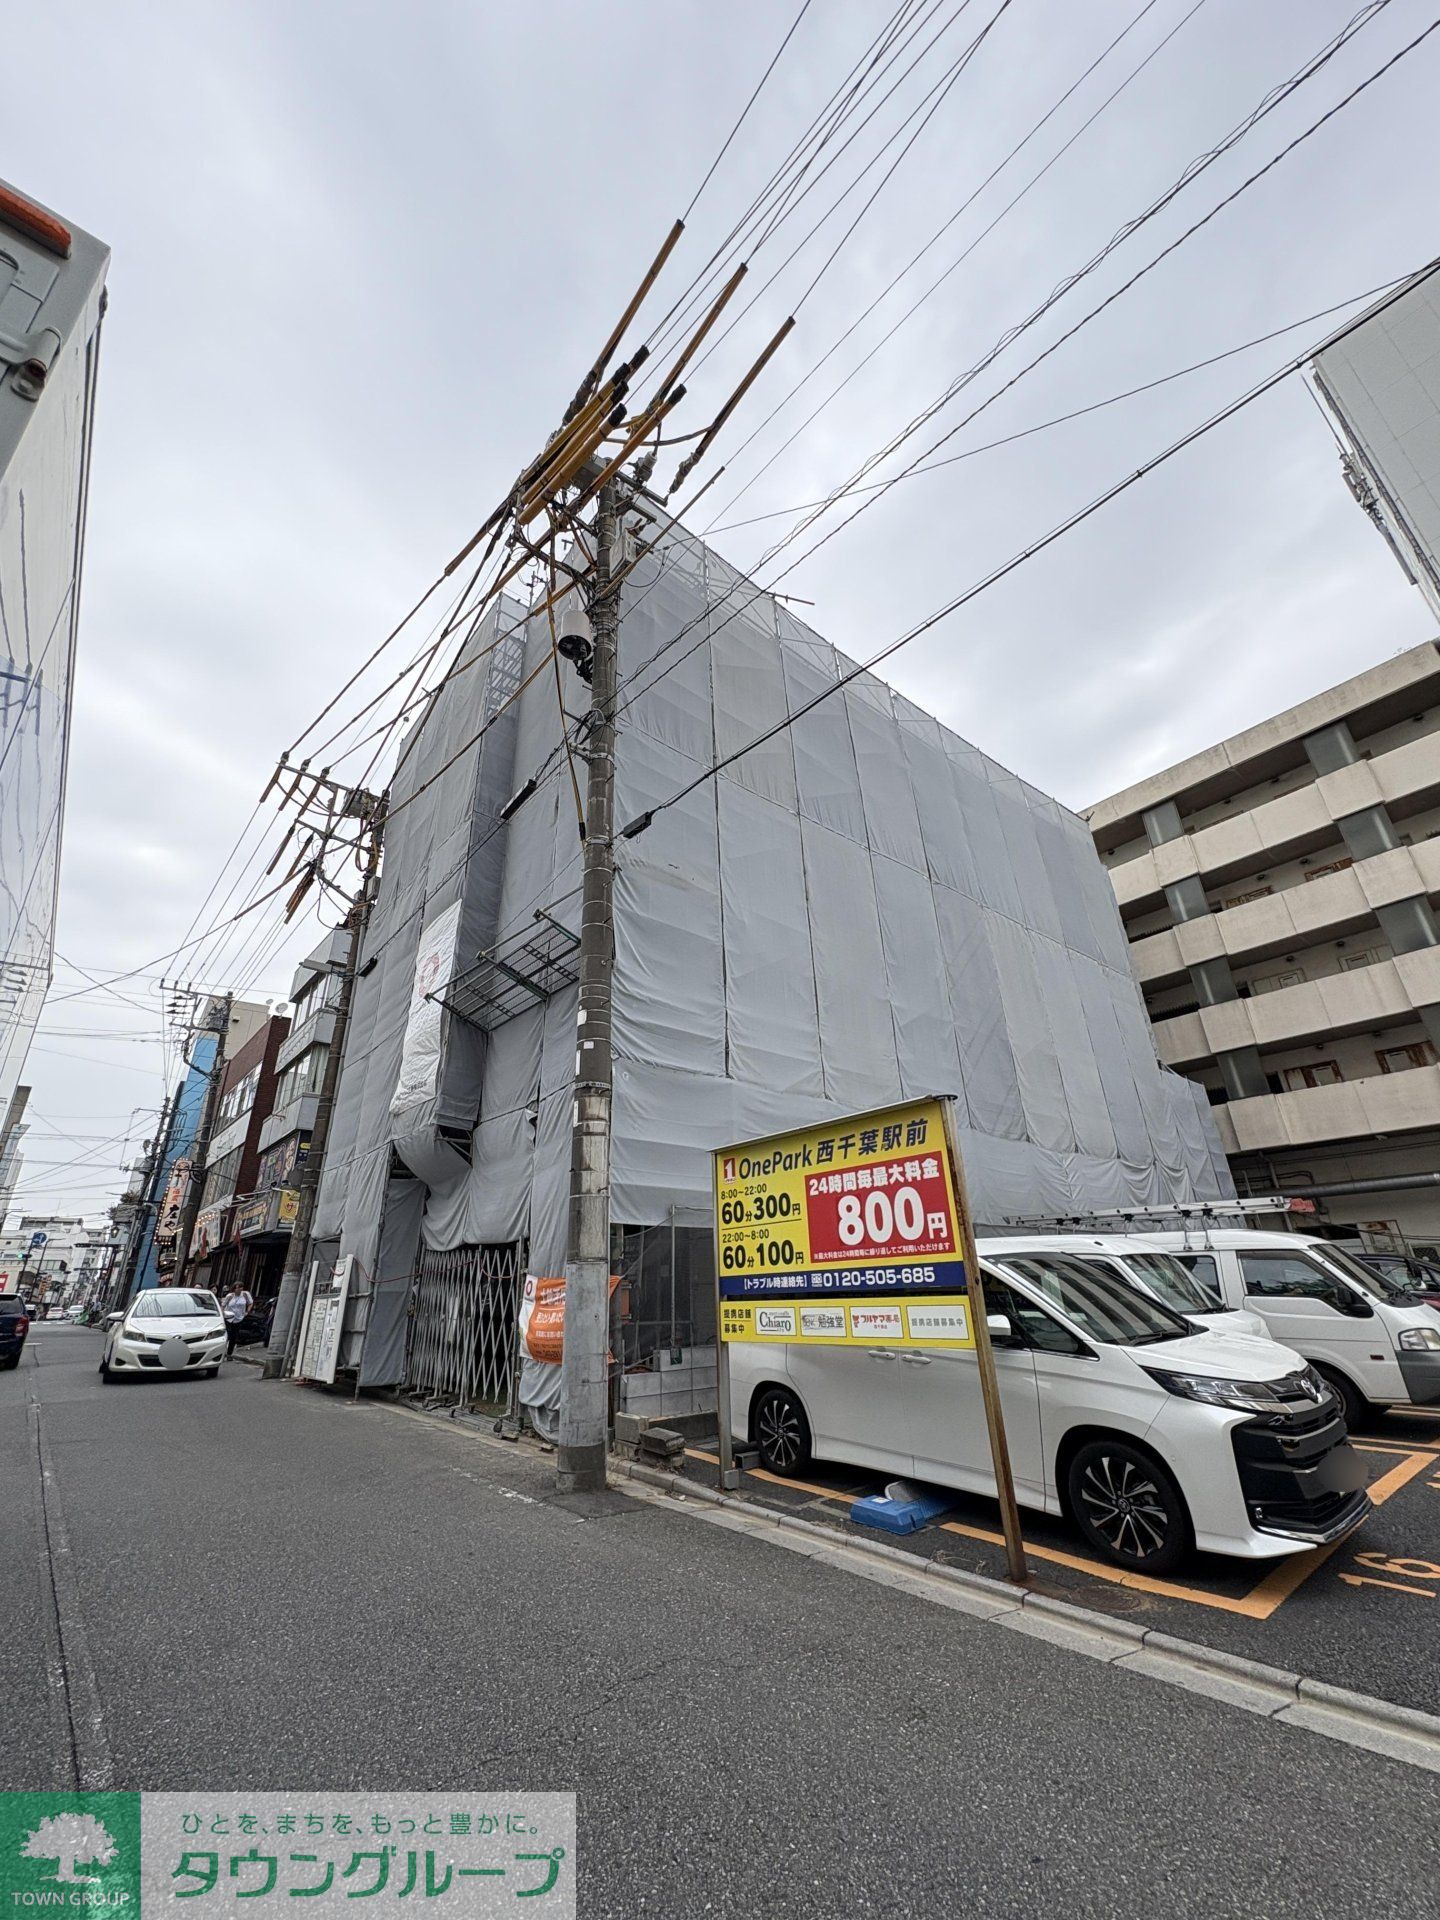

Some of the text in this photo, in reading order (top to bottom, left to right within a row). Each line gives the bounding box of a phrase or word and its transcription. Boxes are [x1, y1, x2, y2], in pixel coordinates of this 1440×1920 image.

[739, 1144, 812, 1180] OnePark
[816, 1119, 929, 1166] 西千葉駅前
[809, 1158, 940, 1196] 24時間毎最大料金
[721, 1192, 801, 1225] 60分300円
[837, 1186, 948, 1246] 800円
[722, 1240, 804, 1269] 60分100円
[823, 1266, 935, 1288] 0120-505-685
[723, 1308, 751, 1319] 提携店舗
[759, 1311, 792, 1332] Chiaro
[724, 1323, 745, 1334] 募集中
